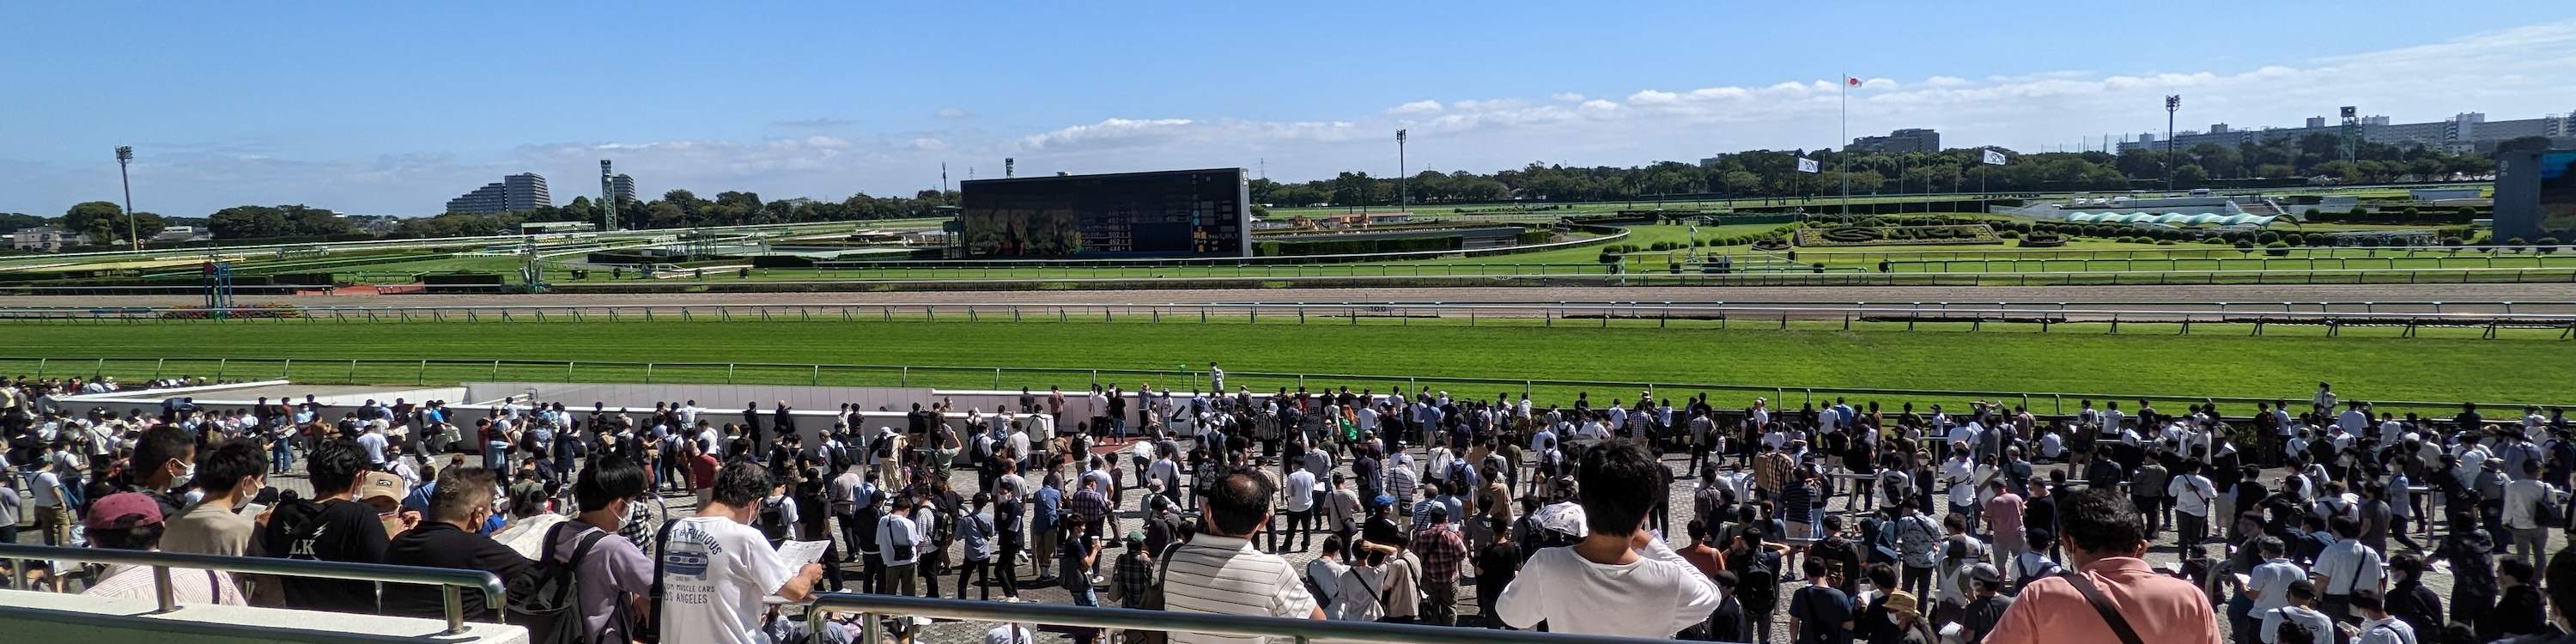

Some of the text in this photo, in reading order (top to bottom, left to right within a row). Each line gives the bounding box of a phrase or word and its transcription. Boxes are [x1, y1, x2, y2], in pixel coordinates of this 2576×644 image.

[289, 539, 316, 555] LK
[686, 528, 722, 556] FURIOUS
[676, 584, 696, 592] MUSCLE
[665, 591, 708, 605] OS ANGELES
